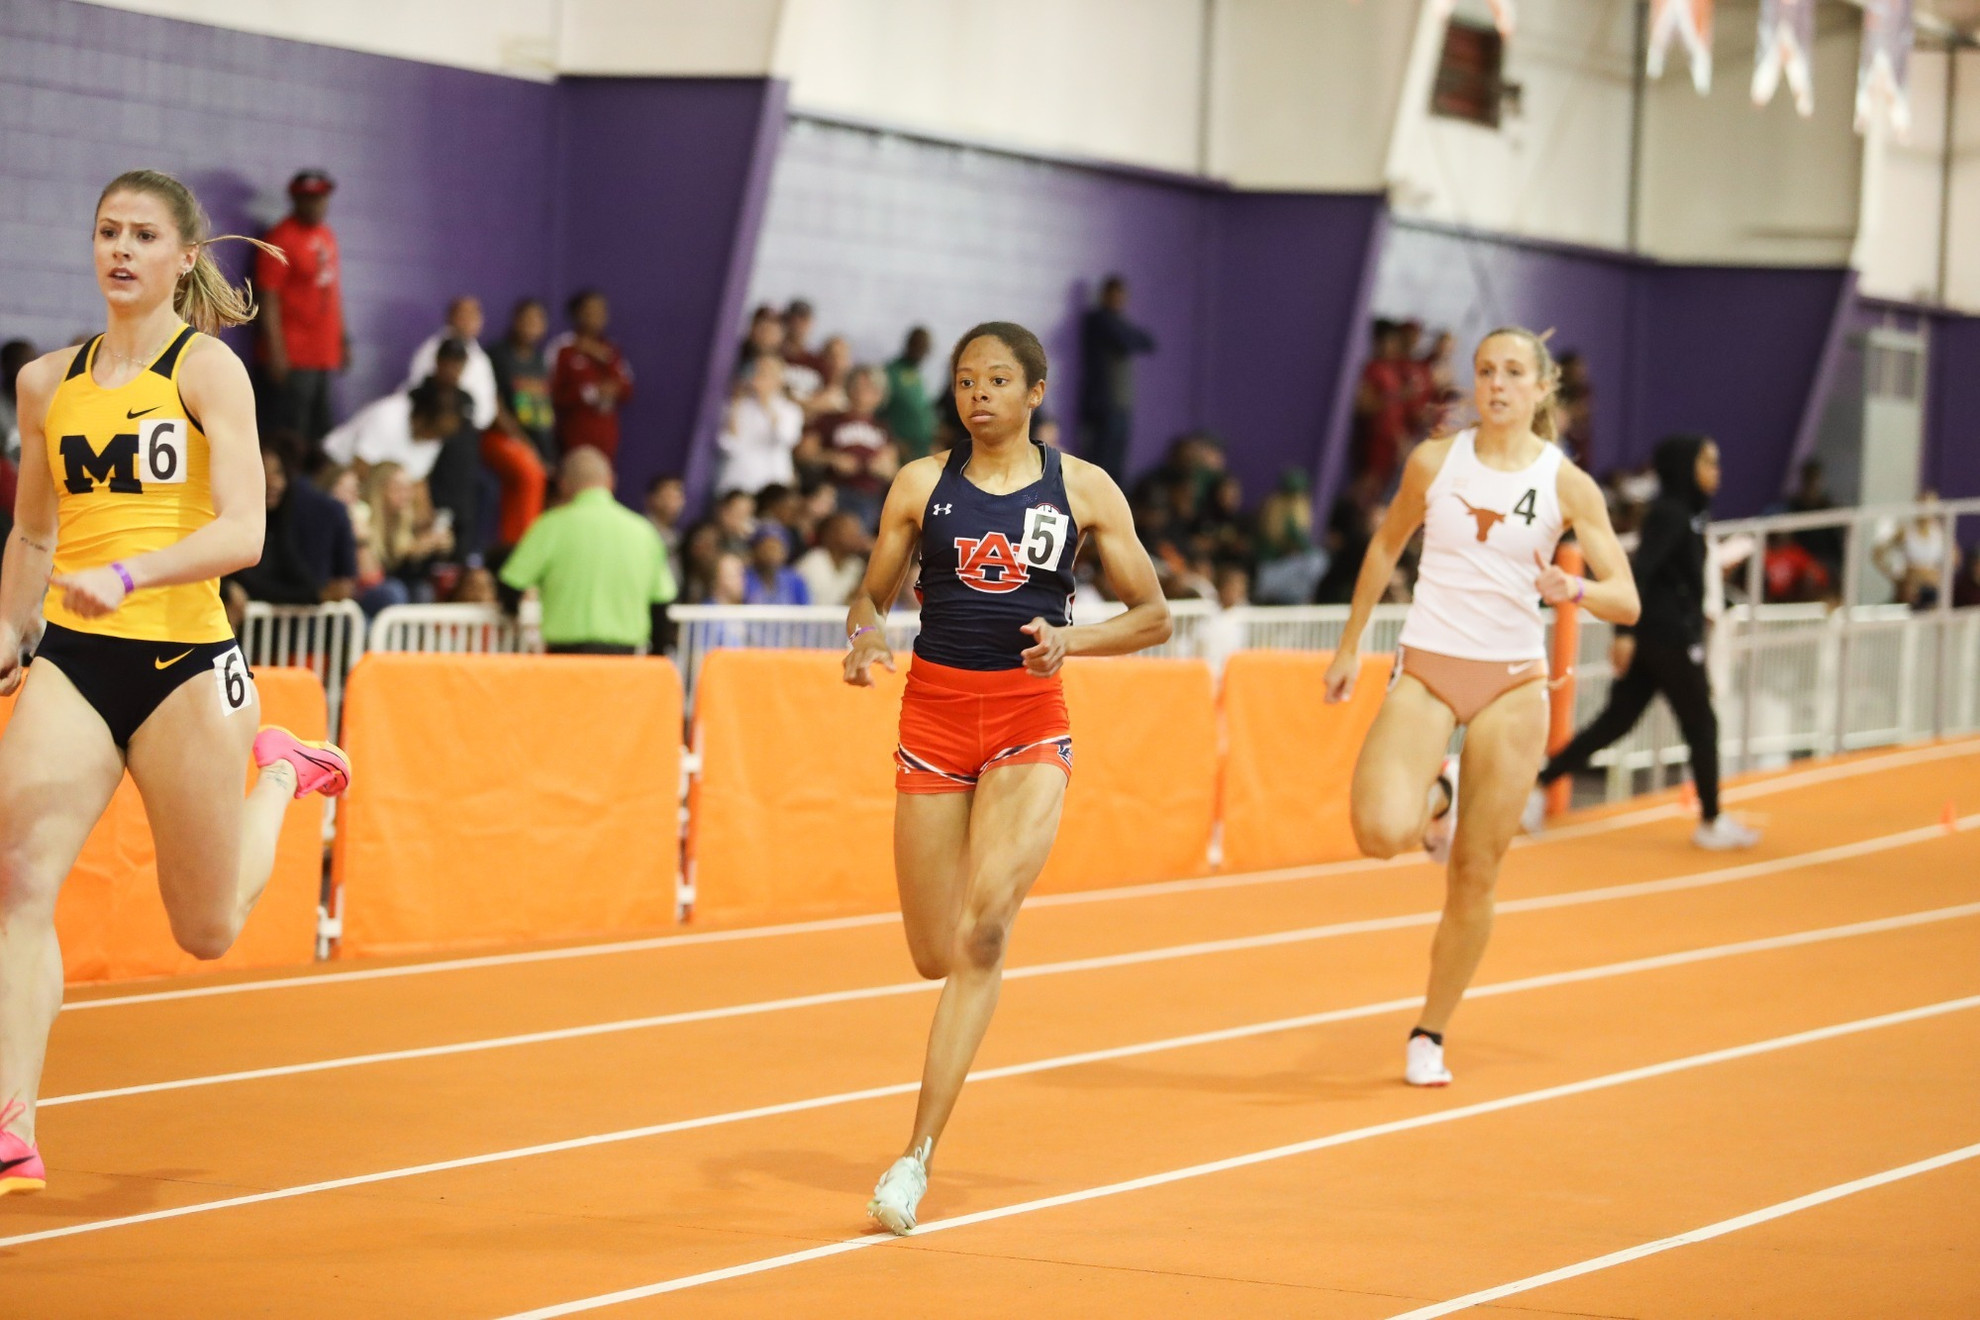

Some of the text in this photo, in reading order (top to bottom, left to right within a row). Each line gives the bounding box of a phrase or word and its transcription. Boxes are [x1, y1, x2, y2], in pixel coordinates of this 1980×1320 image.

[59, 434, 143, 494] M
[149, 423, 177, 480] 6
[1513, 488, 1536, 525] 4
[1027, 514, 1057, 565] 5
[224, 652, 245, 708] 6
